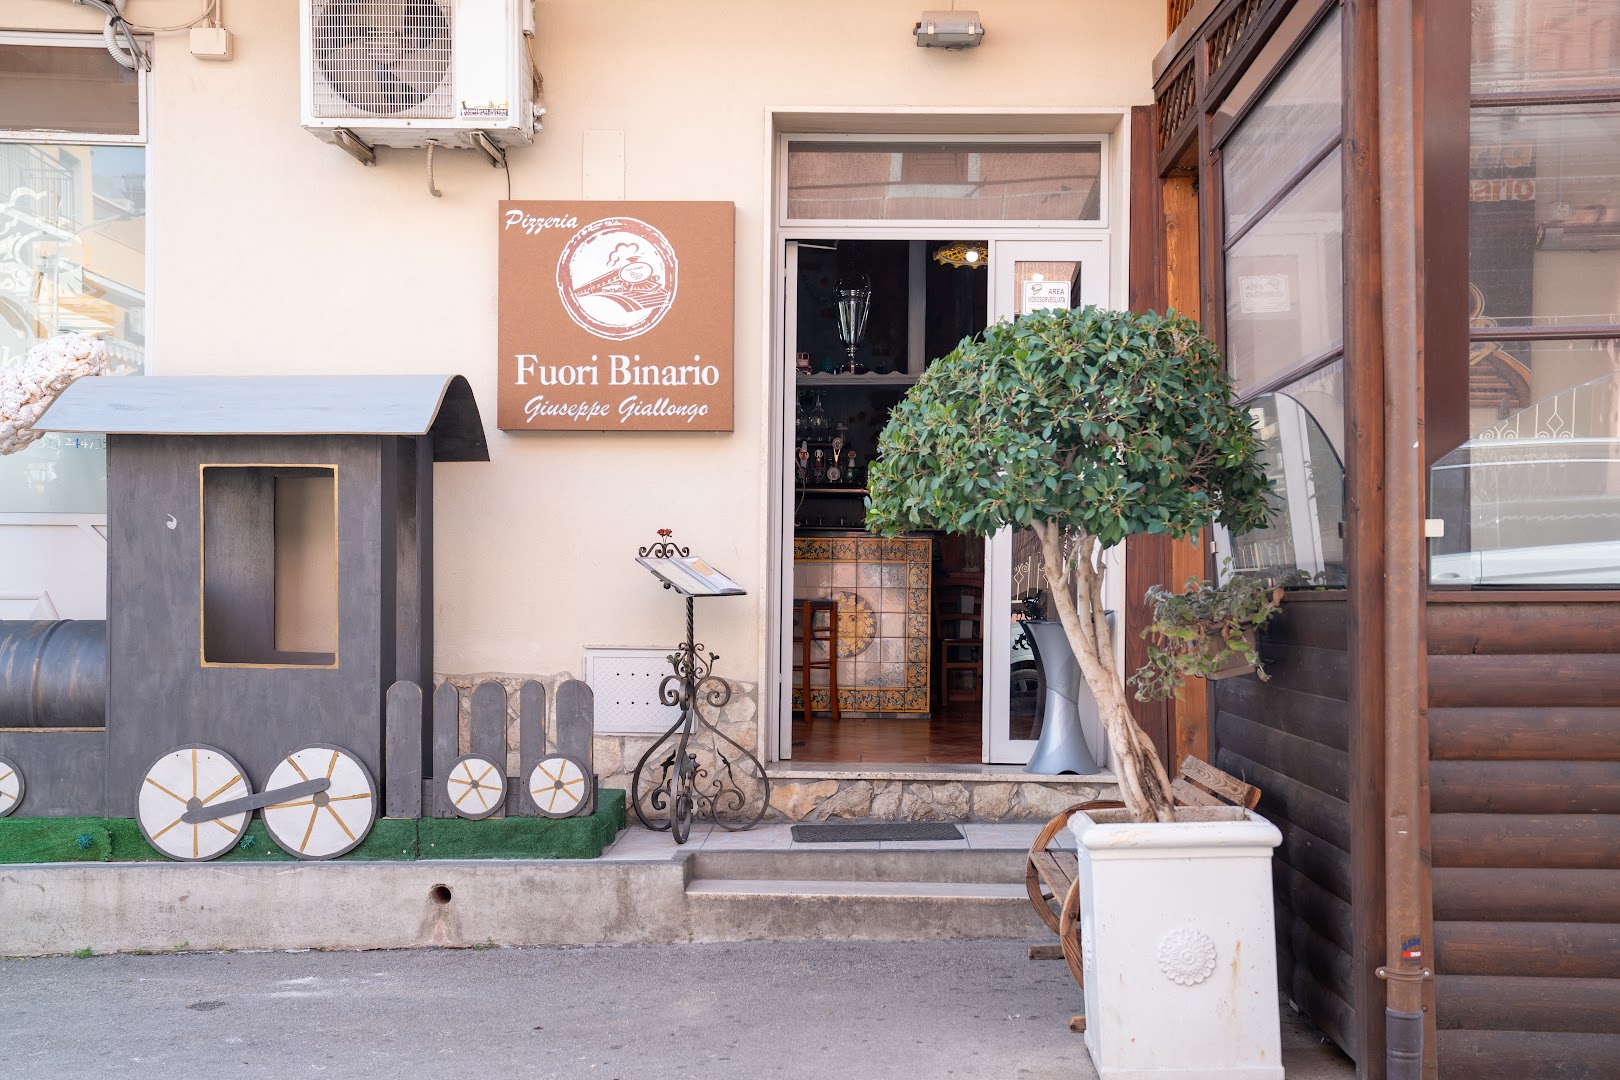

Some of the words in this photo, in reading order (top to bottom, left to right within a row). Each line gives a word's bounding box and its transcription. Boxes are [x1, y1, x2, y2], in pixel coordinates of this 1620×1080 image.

[505, 209, 578, 235] Pizzeria
[514, 354, 599, 386] Fuori
[608, 354, 720, 386] Binario
[524, 394, 610, 423] Giuseppe
[618, 394, 709, 423] Giallongo
